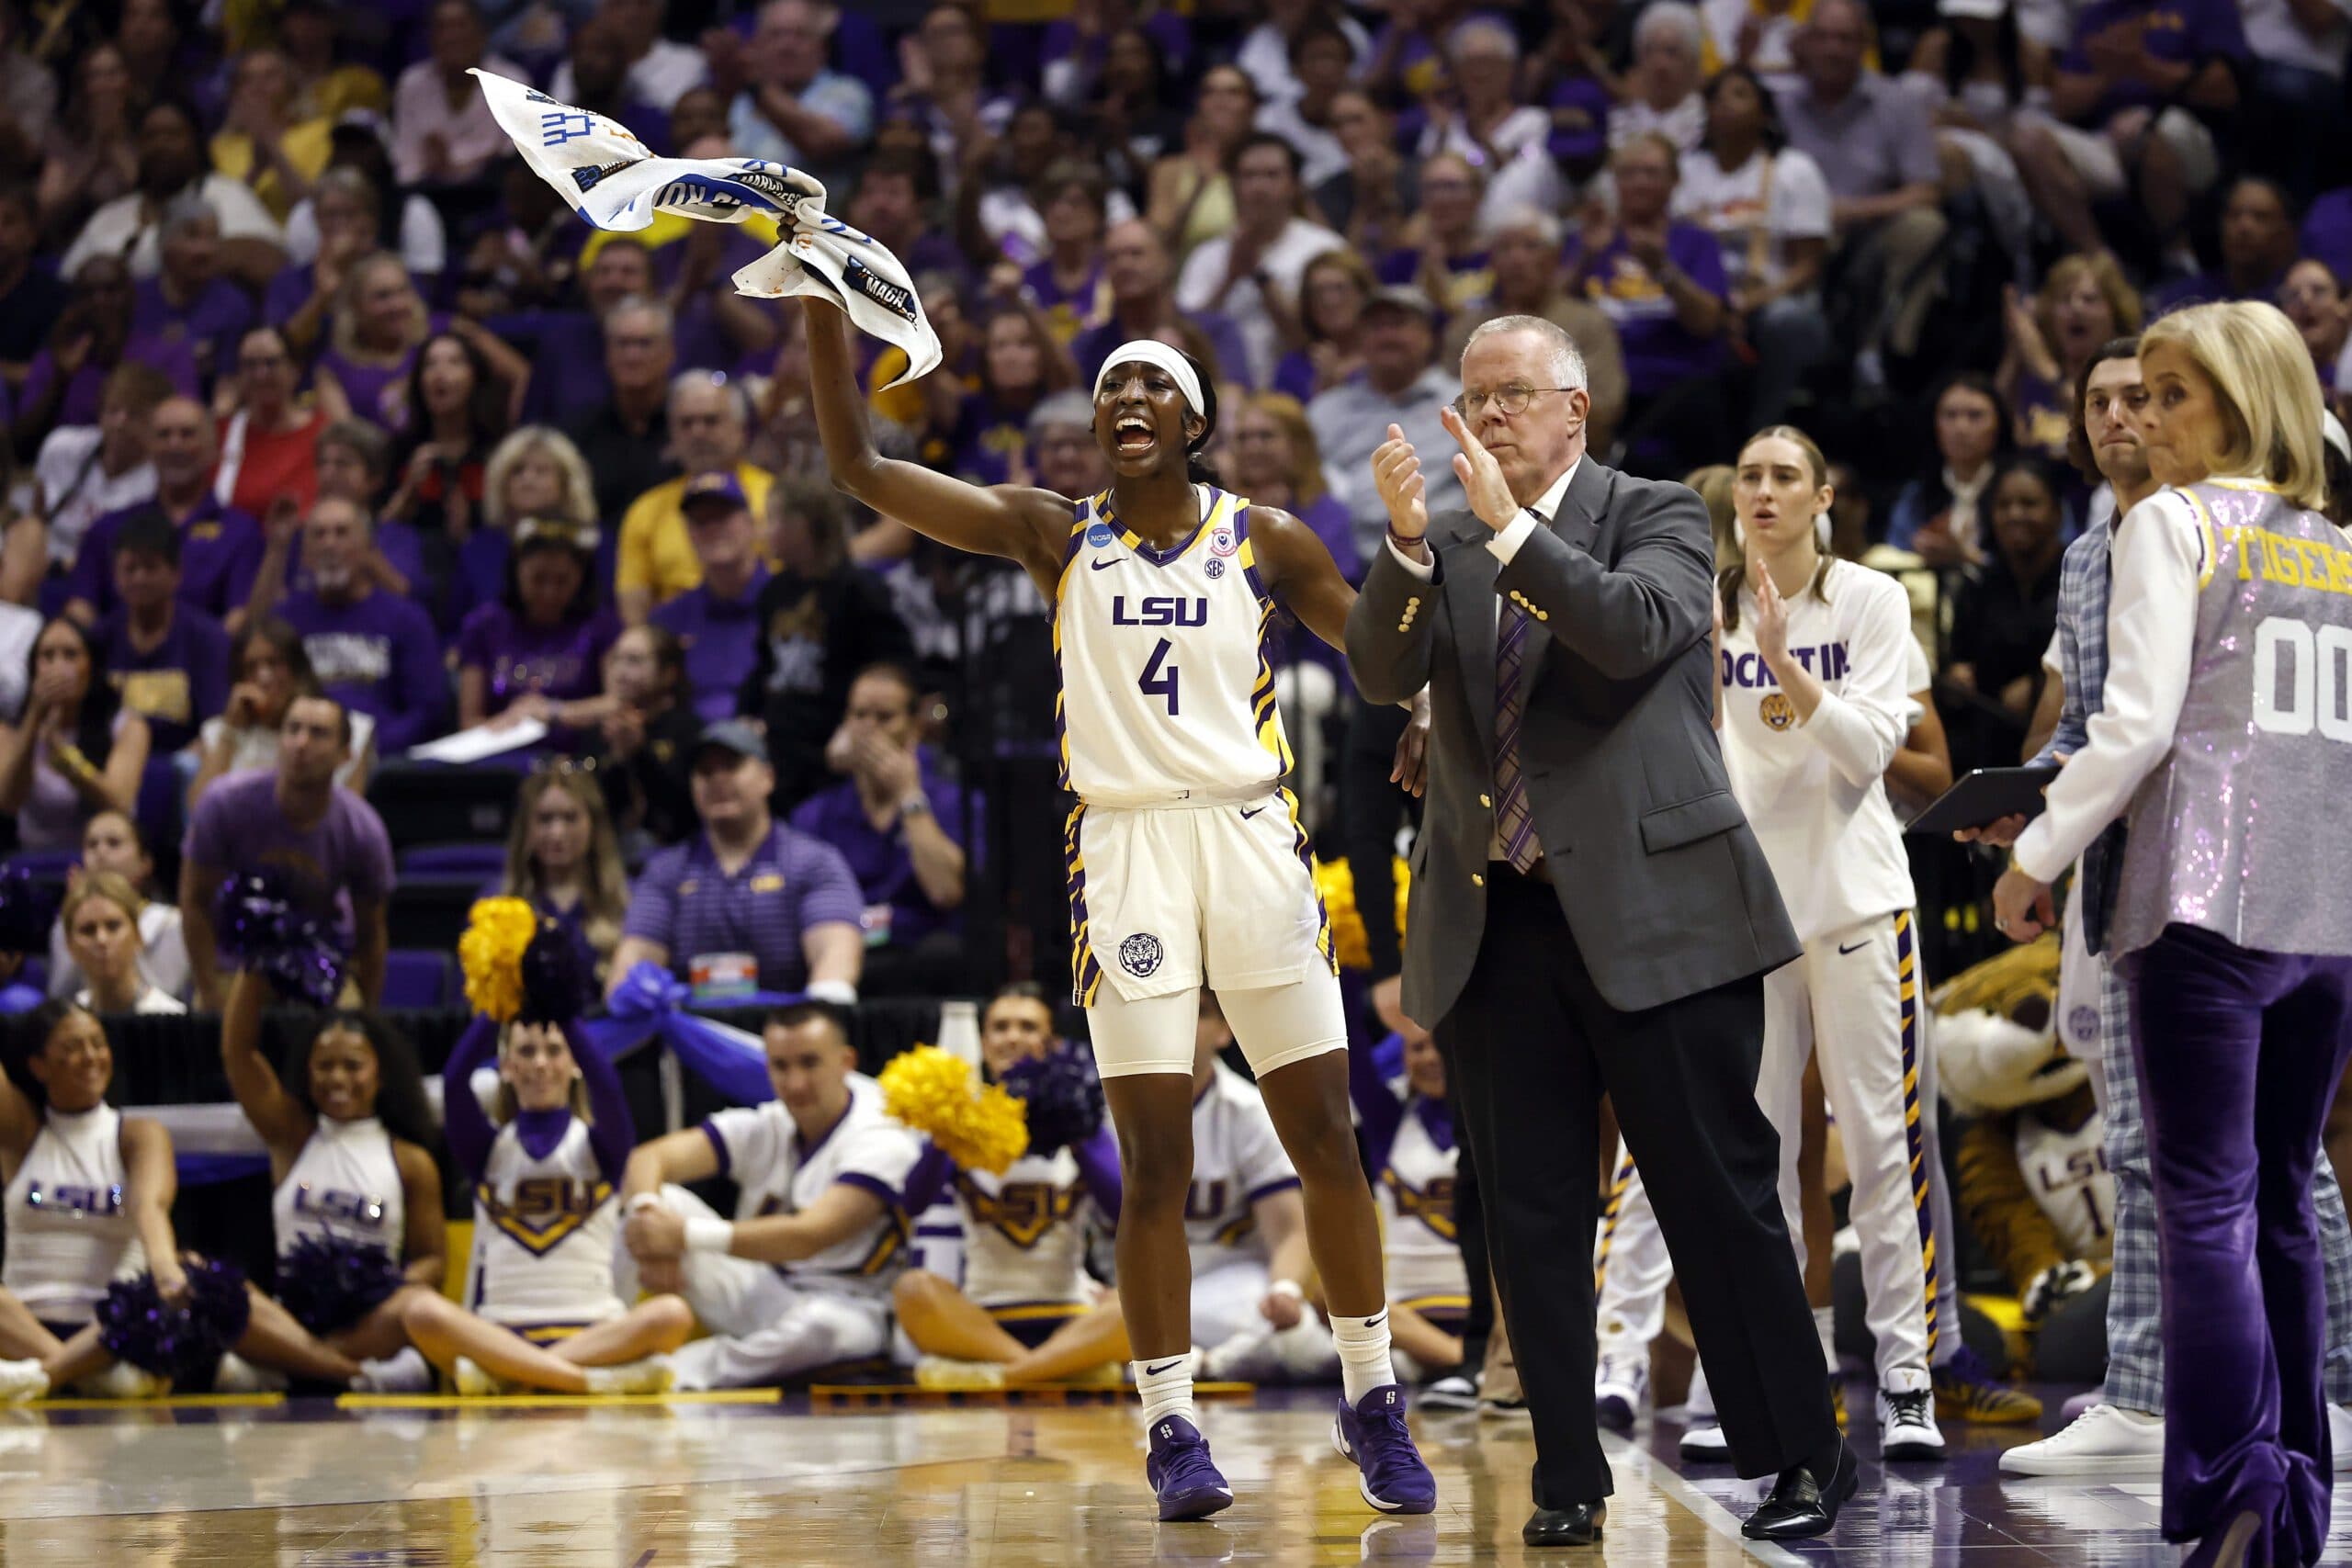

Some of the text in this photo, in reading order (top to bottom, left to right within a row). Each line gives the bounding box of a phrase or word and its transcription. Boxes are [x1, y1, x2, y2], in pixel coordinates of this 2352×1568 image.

[1091, 534, 1111, 542] NCAA
[1206, 560, 1223, 576] SEC
[1113, 596, 1207, 626] LSU
[1138, 637, 1179, 716] 4
[1721, 649, 1779, 687] OCK
[2252, 616, 2352, 743] 00
[29, 1180, 120, 1214] LSU
[294, 1183, 388, 1227] LSU
[2081, 1186, 2107, 1238] 1
